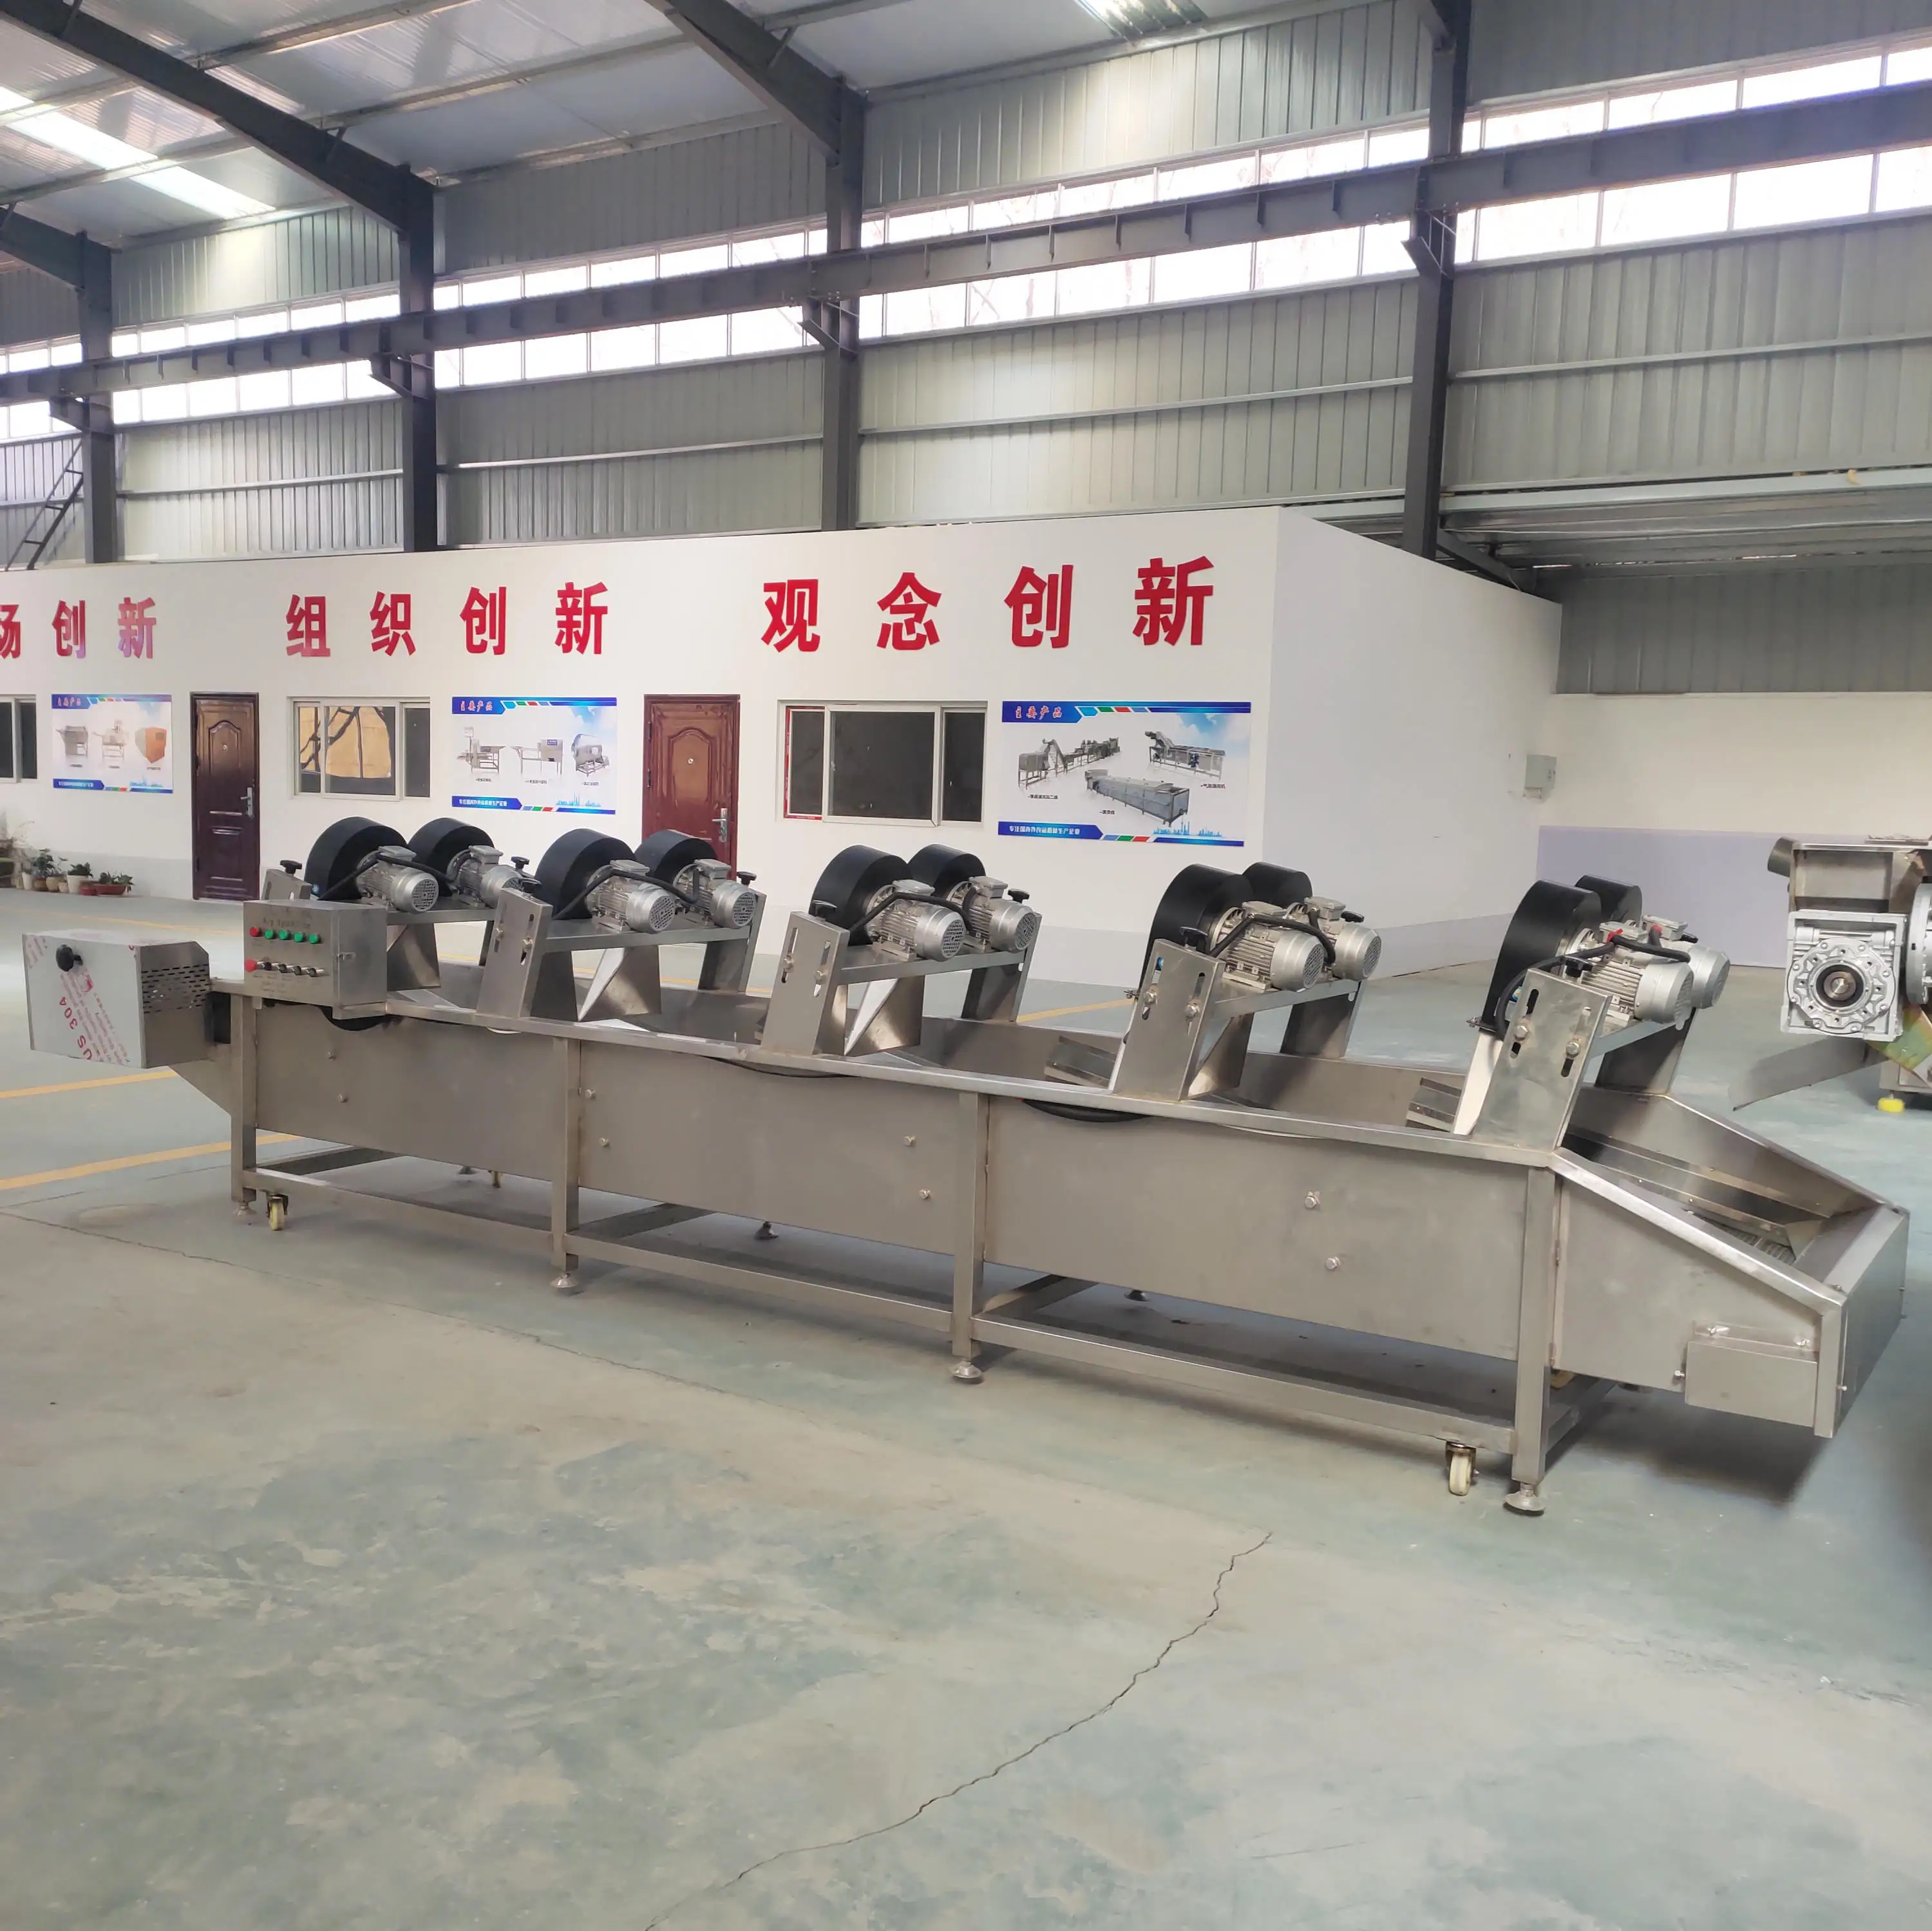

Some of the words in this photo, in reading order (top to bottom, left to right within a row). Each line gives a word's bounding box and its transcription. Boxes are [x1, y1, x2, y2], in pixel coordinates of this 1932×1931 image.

[285, 581, 609, 657] 组织创新
[761, 556, 1214, 653] 观念创新
